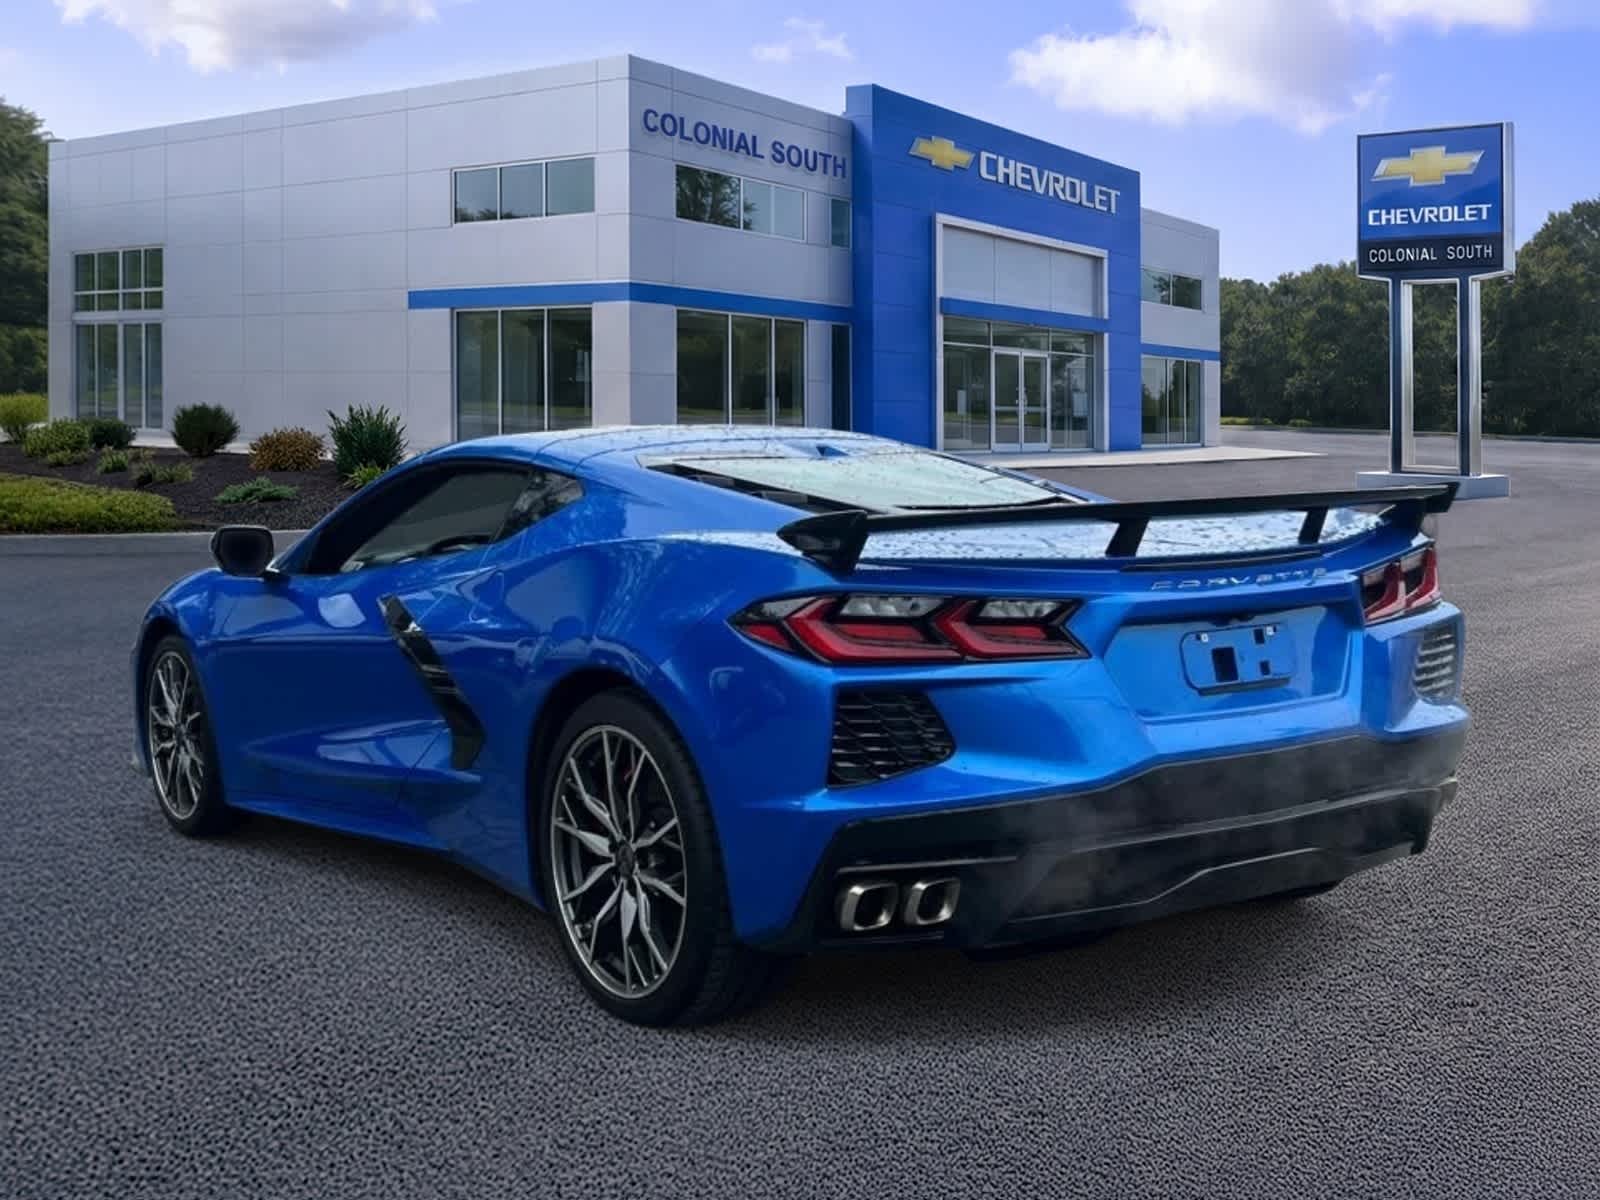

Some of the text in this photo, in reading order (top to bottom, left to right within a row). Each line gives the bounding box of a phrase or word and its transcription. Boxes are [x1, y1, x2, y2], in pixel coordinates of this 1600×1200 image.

[643, 108, 847, 178] COLONIAL SOUTH
[979, 150, 1121, 214] CHEVROLET
[1368, 204, 1492, 226] CHEVROLET
[1369, 244, 1493, 263] COLONIAL SOUTH
